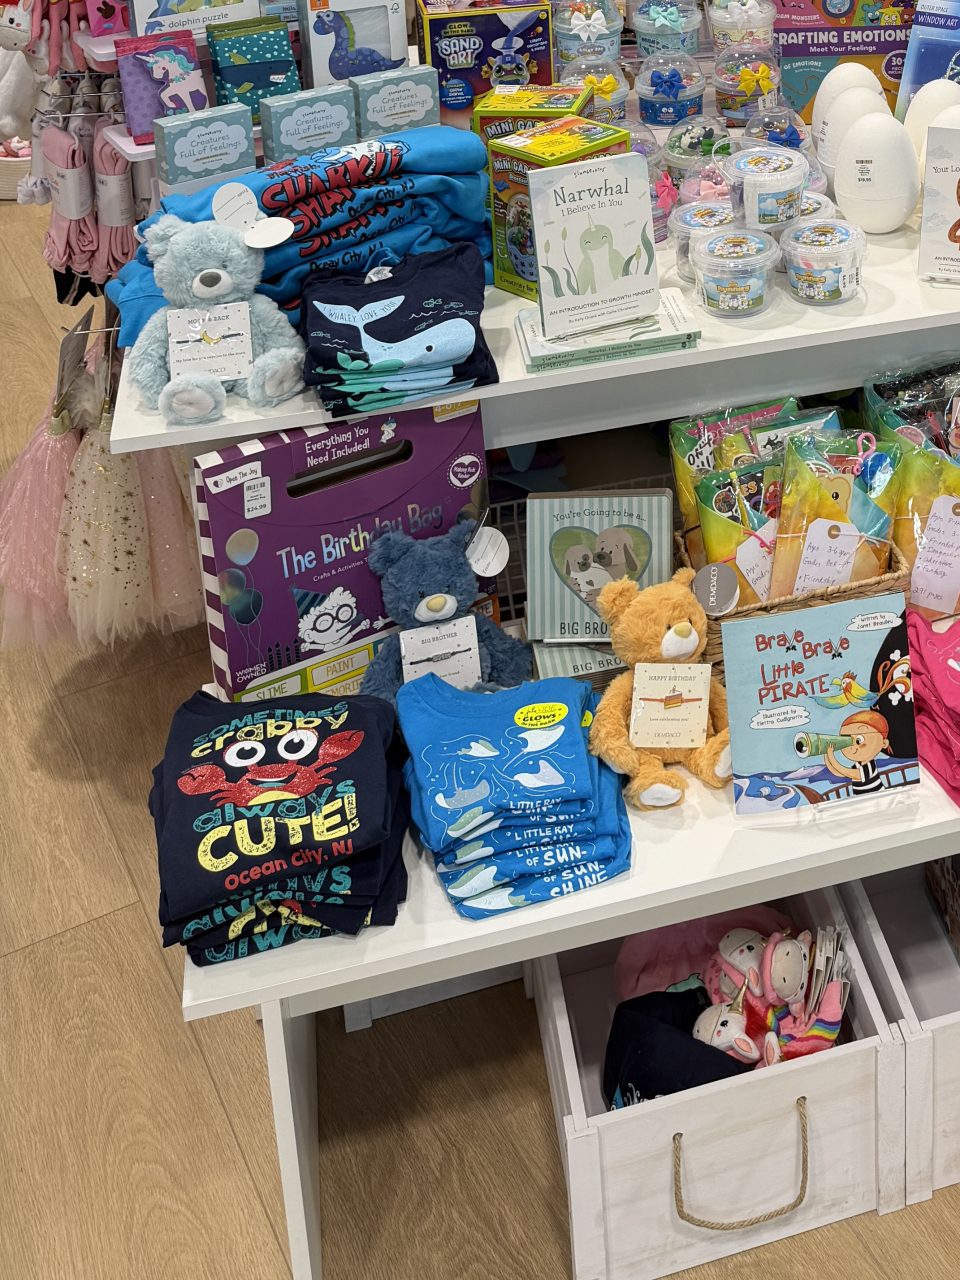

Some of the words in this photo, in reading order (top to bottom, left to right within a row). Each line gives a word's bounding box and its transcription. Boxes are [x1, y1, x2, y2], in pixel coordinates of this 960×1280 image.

[168, 15, 201, 29] dolphin
[202, 11, 229, 25] puzzle
[441, 37, 479, 54] SAND
[830, 45, 846, 53] Your
[847, 44, 877, 53] Feelings
[450, 49, 474, 65] ART
[372, 105, 387, 115] Full
[398, 98, 429, 112] Feelings
[382, 92, 419, 106] Creatures
[285, 128, 301, 138] Full
[313, 119, 344, 133] Feelings
[295, 113, 333, 127] Creatures
[180, 150, 194, 159] Full
[206, 140, 242, 156] Feelings
[191, 135, 230, 148] Creatures
[932, 165, 949, 175] Your
[553, 177, 630, 207] Narwhal
[567, 202, 597, 216] Believe
[598, 200, 607, 209] In
[608, 198, 624, 208] You
[558, 301, 600, 316] INTRODUCTION
[608, 293, 632, 304] GROWTH
[632, 288, 655, 299] MINDSET
[328, 311, 357, 324] WHALEY
[360, 310, 380, 323] LOVE
[304, 431, 351, 455] Everything
[353, 425, 369, 441] You
[306, 452, 330, 468] Need
[331, 437, 371, 462] Included!
[553, 510, 582, 522] You're
[583, 508, 611, 519] Going
[612, 508, 622, 517] to
[624, 508, 634, 518] be
[275, 546, 317, 579] The
[407, 502, 444, 530] Bag
[928, 537, 960, 552] Friendship
[312, 572, 329, 583] Crafts
[337, 558, 364, 574] Activities
[802, 573, 837, 587] Friendship
[709, 566, 718, 607] DEMDACO
[559, 621, 582, 636] BIG
[754, 629, 805, 653] Brave
[801, 635, 850, 660] Brave
[235, 662, 267, 677] WOMEN
[236, 667, 268, 683] OWNED
[326, 656, 355, 677] PAINT
[572, 662, 595, 674] BIG
[759, 660, 806, 687] Little
[255, 682, 288, 701] SLIME
[757, 673, 830, 705] PIRATE
[192, 700, 349, 748] SOMETIMES
[522, 713, 556, 723] GLOWS
[190, 711, 349, 759] crabby
[192, 779, 357, 833] always
[197, 792, 361, 873] CUTE!
[514, 828, 552, 841] LITTLE
[554, 823, 575, 836] RAY
[224, 858, 288, 890] Ocean
[291, 847, 329, 867] City,
[331, 838, 354, 857] NJ
[526, 857, 540, 867] OF
[543, 844, 588, 867] SUN-
[543, 873, 558, 883] OF
[560, 860, 606, 880] SUN-
